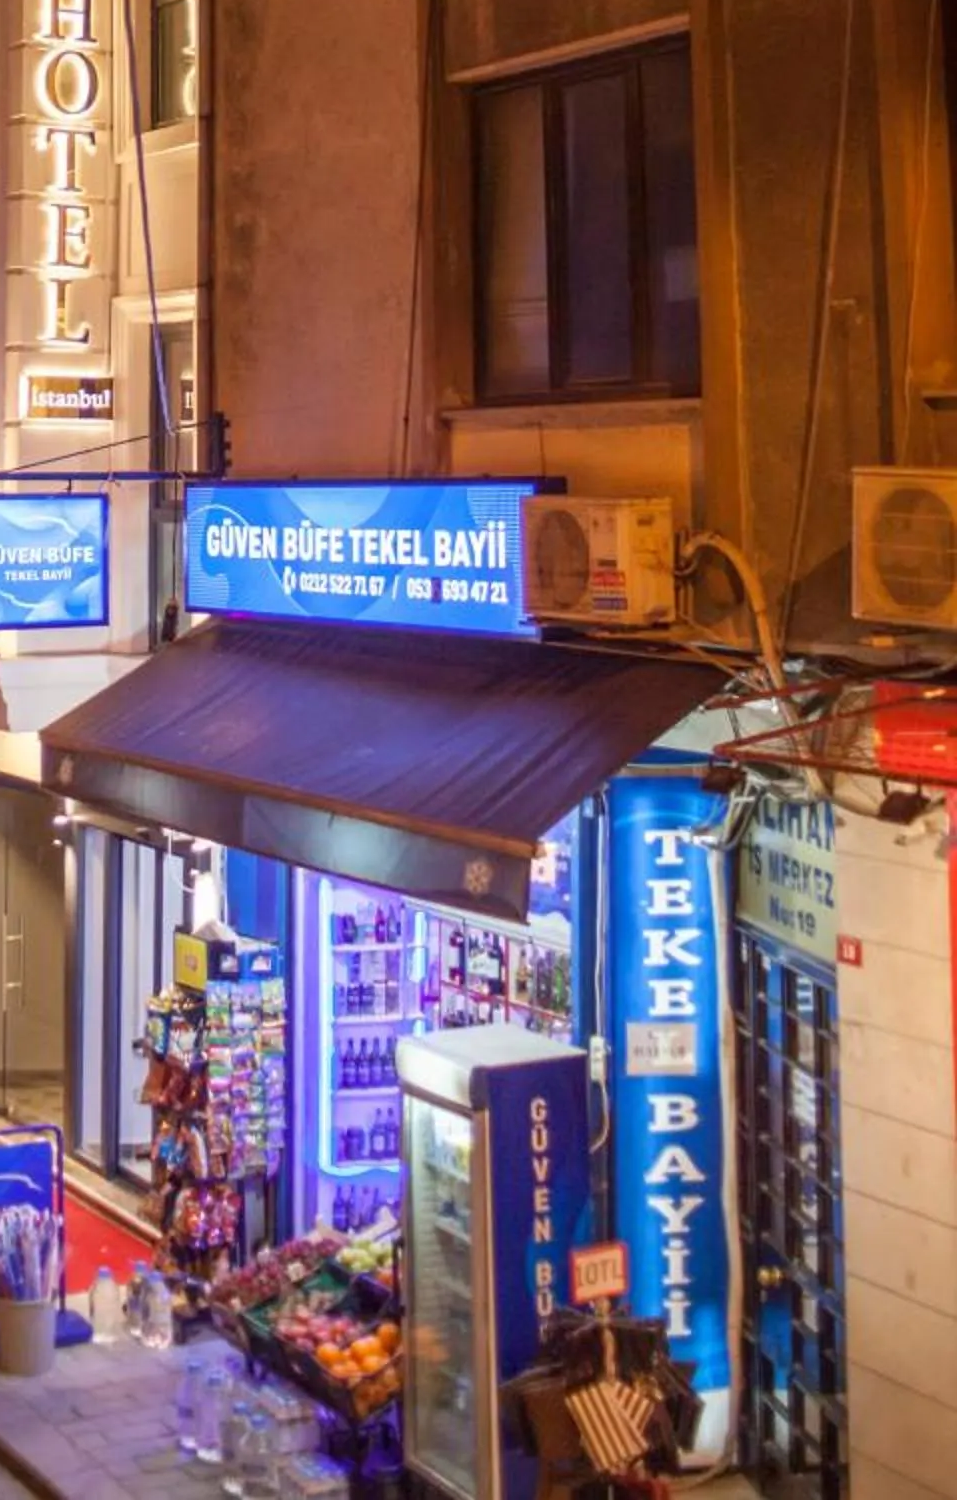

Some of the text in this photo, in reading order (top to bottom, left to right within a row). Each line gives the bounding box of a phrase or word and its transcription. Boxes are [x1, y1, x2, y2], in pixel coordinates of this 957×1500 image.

[48, 542, 94, 563] BÜFE
[206, 518, 508, 570] GÜVEN BÜFE TEKEL BAYİİ
[5, 569, 39, 581] TEKEL
[407, 578, 441, 602] 053
[643, 828, 703, 1067] TEKEL
[531, 1097, 553, 1242] GÜVEN
[644, 1093, 705, 1337] BAYİİ
